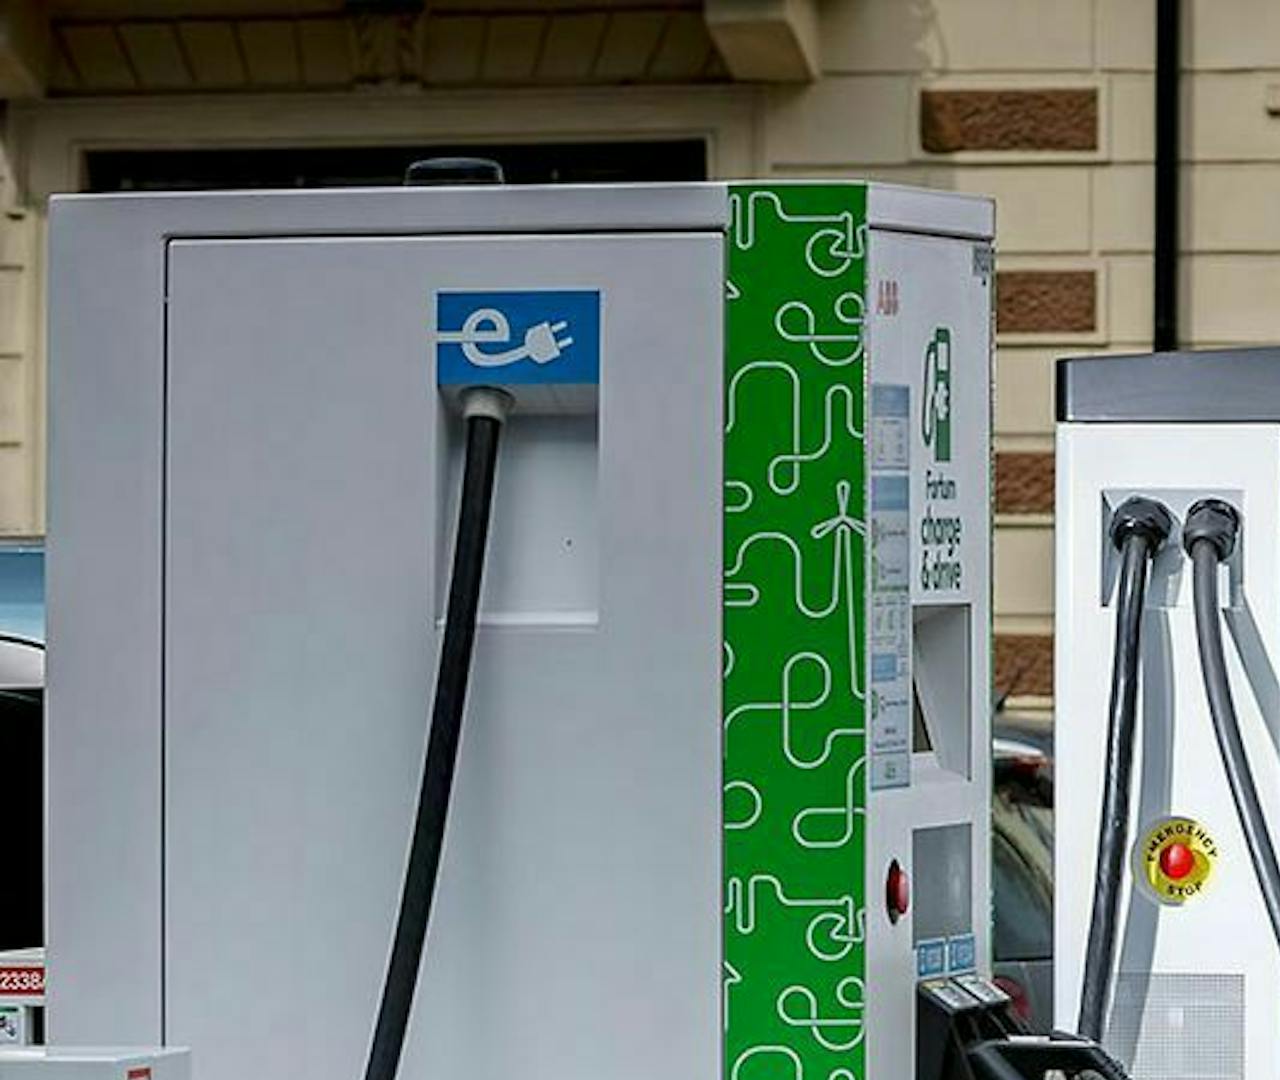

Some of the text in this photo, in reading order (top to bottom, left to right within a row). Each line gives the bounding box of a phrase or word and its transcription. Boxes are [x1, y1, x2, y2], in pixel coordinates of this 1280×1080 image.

[925, 469, 957, 501] Fortum
[921, 504, 962, 557] charge
[933, 549, 962, 591] drive
[1146, 823, 1218, 863] EMERGENCY
[1167, 881, 1202, 896] STOP
[0, 970, 45, 991] 2338
